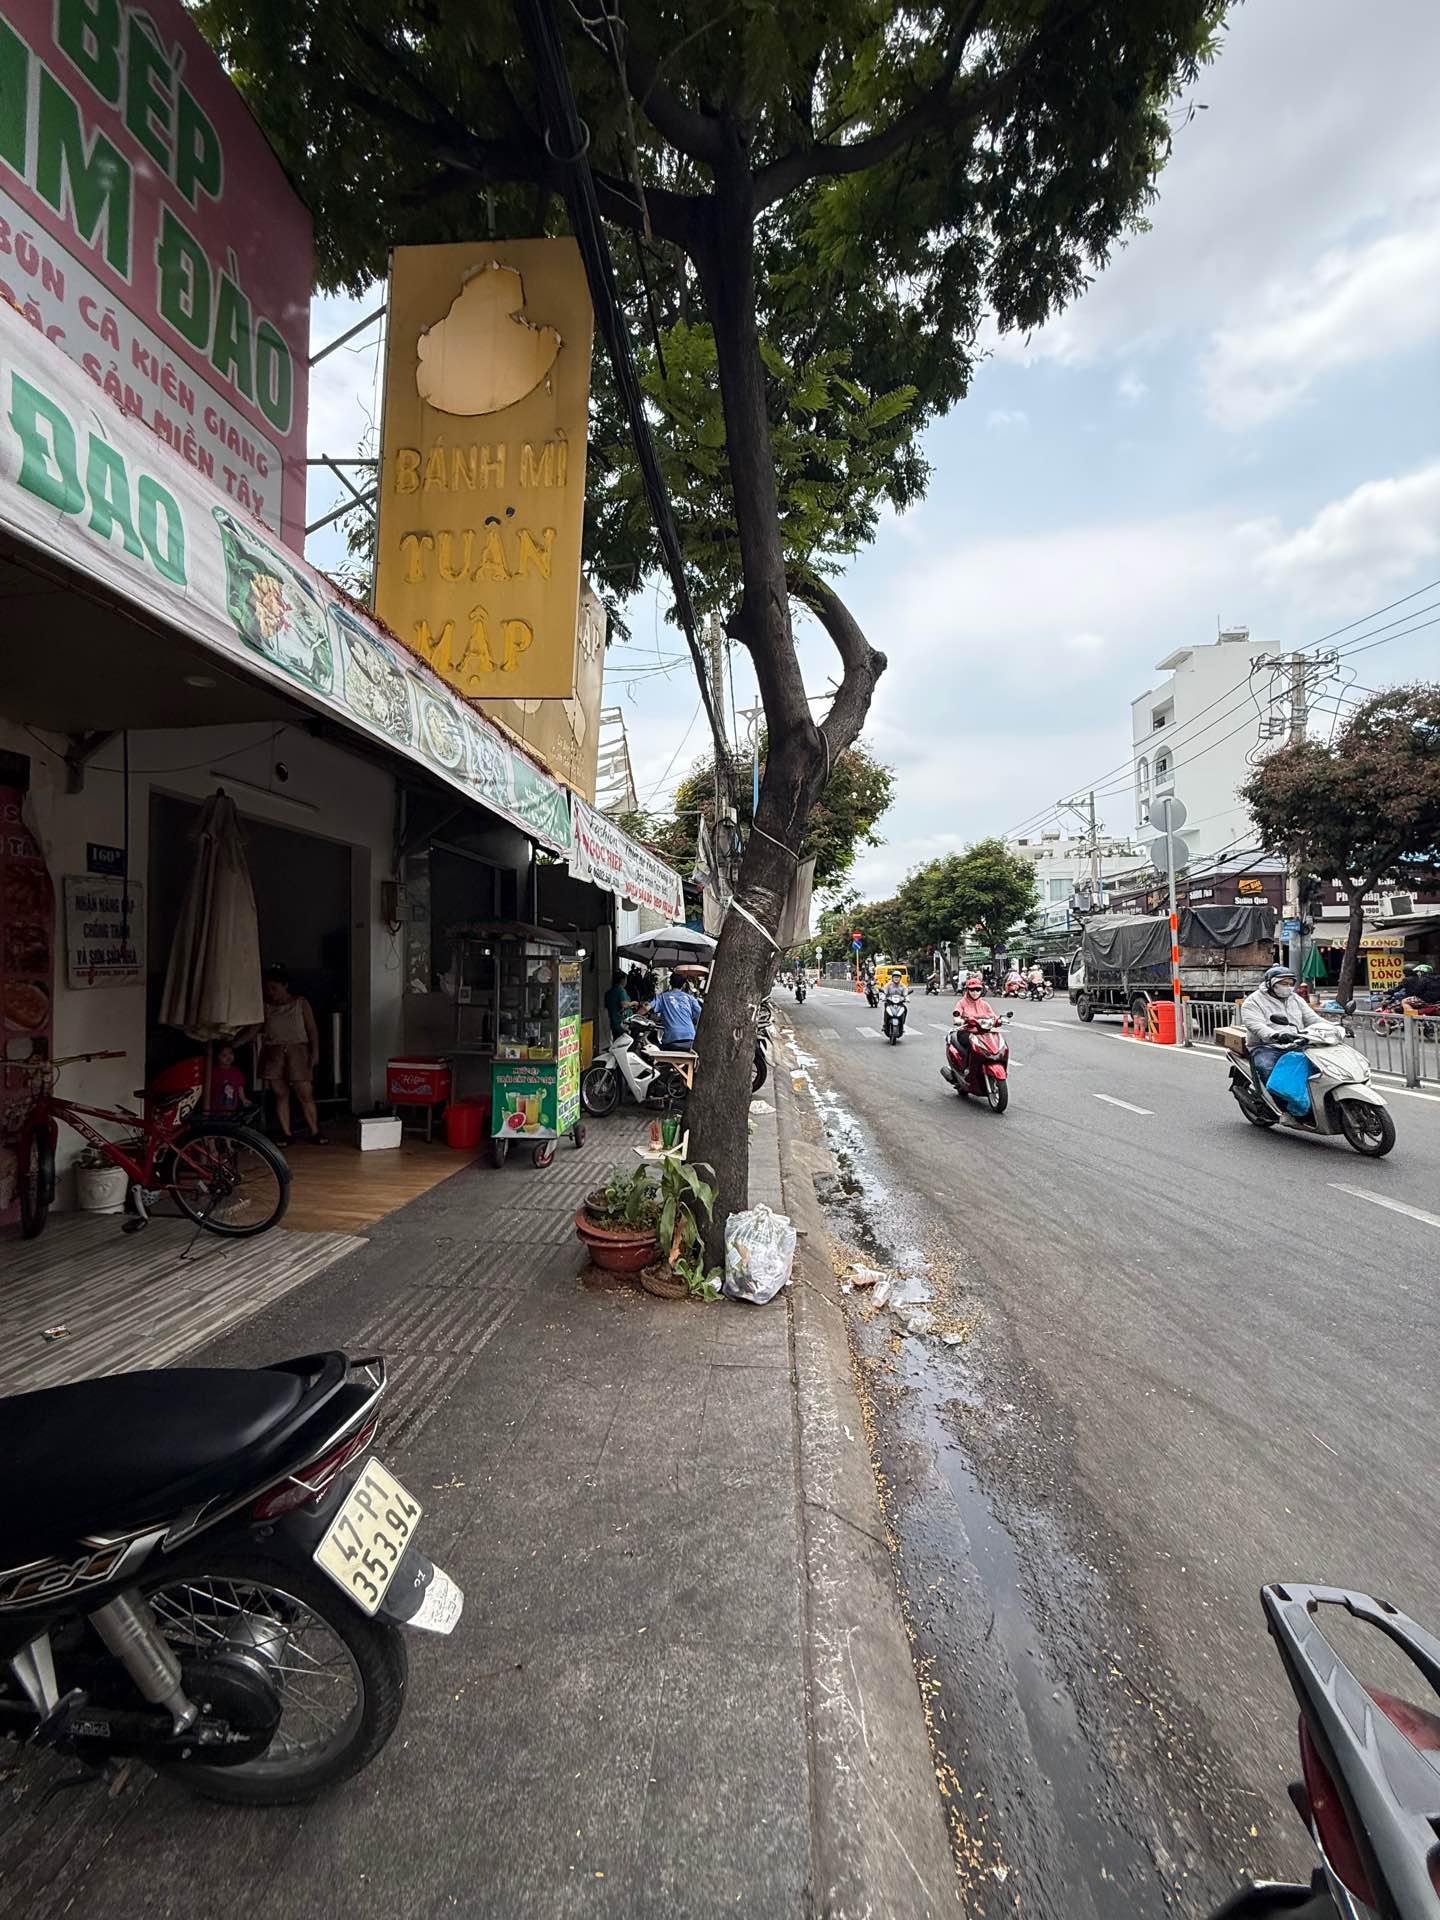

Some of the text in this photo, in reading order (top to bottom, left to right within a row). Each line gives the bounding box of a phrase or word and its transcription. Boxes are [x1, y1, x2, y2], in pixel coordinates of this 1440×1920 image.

[155, 200, 294, 437] ĐÀO
[132, 338, 194, 416] KIÊN
[203, 406, 269, 479] GIANG
[8, 369, 187, 585] ĐÀO
[154, 409, 214, 480] MIỀN
[222, 465, 265, 520] TÂY
[394, 433, 508, 495] BÁNH
[413, 604, 534, 686] MẬP
[331, 1475, 388, 1562] 47-P1
[352, 1493, 418, 1602] 353.94
